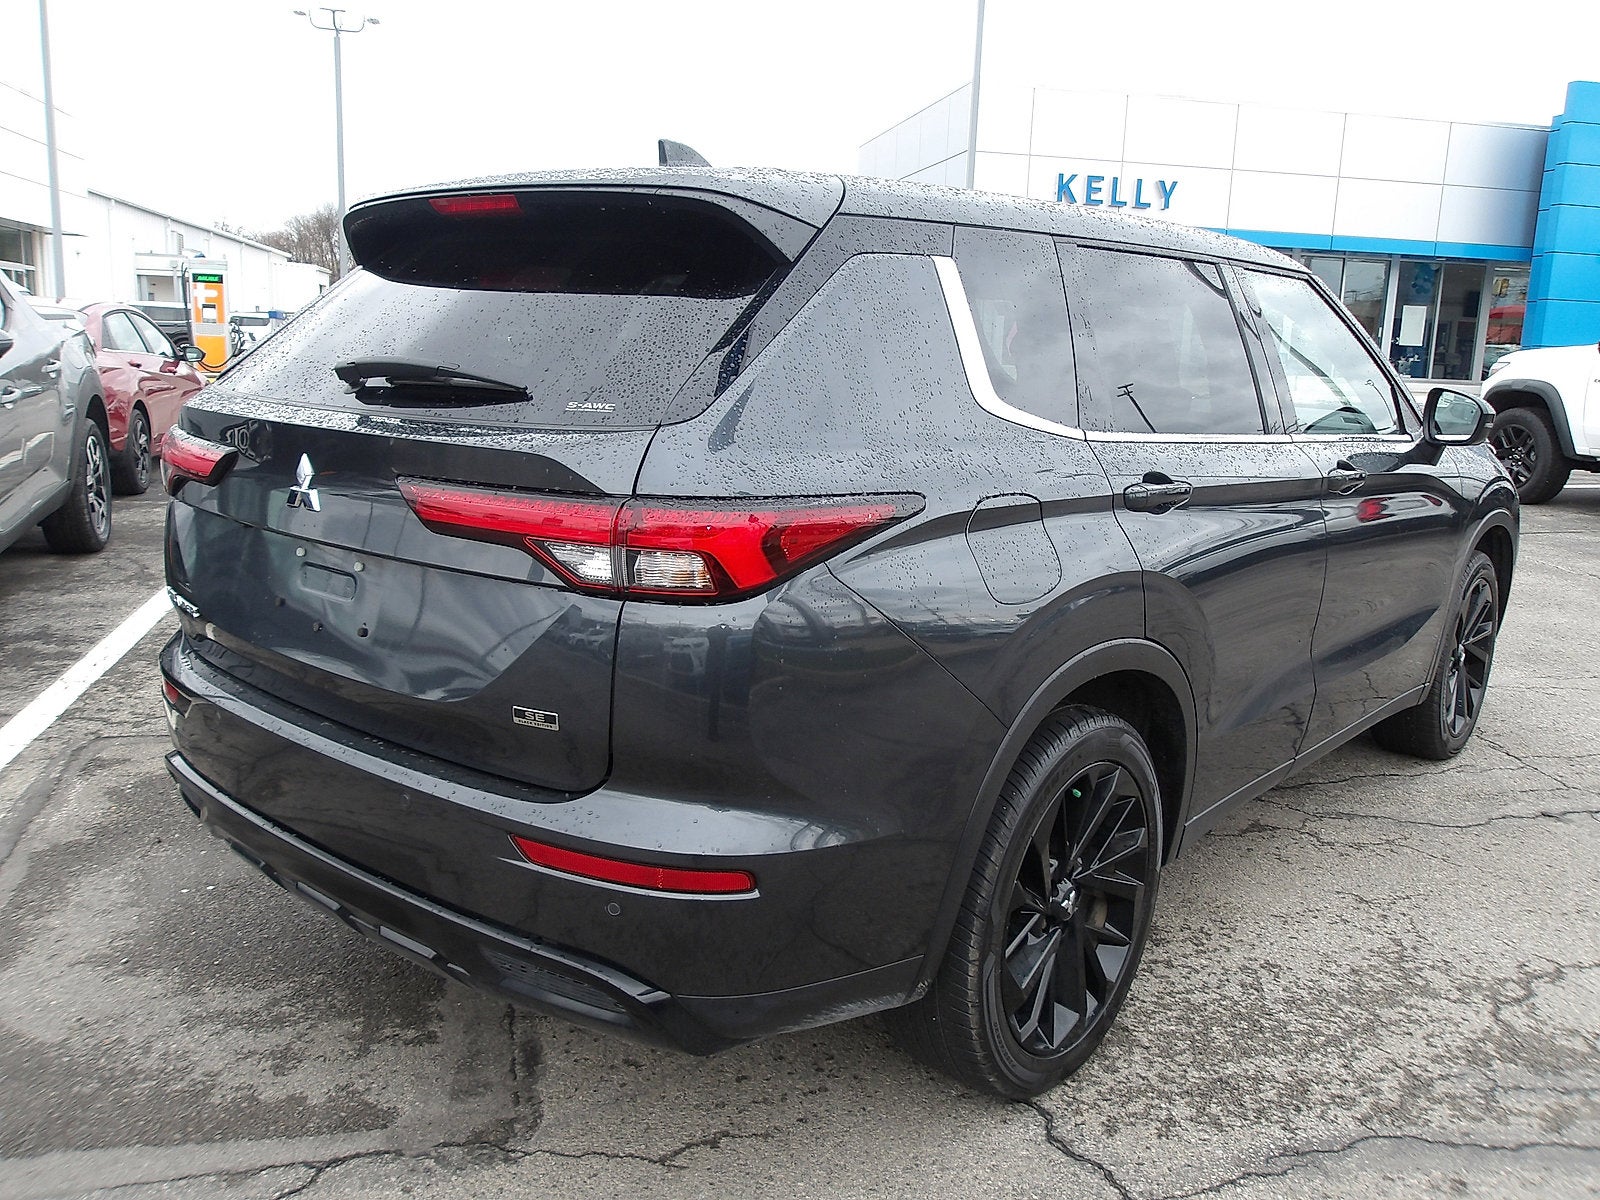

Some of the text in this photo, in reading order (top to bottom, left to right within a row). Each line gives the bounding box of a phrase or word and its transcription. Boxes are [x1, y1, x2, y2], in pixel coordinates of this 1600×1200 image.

[1056, 173, 1178, 209] KELLY
[566, 401, 616, 411] S-AWC
[525, 711, 545, 722] SE
